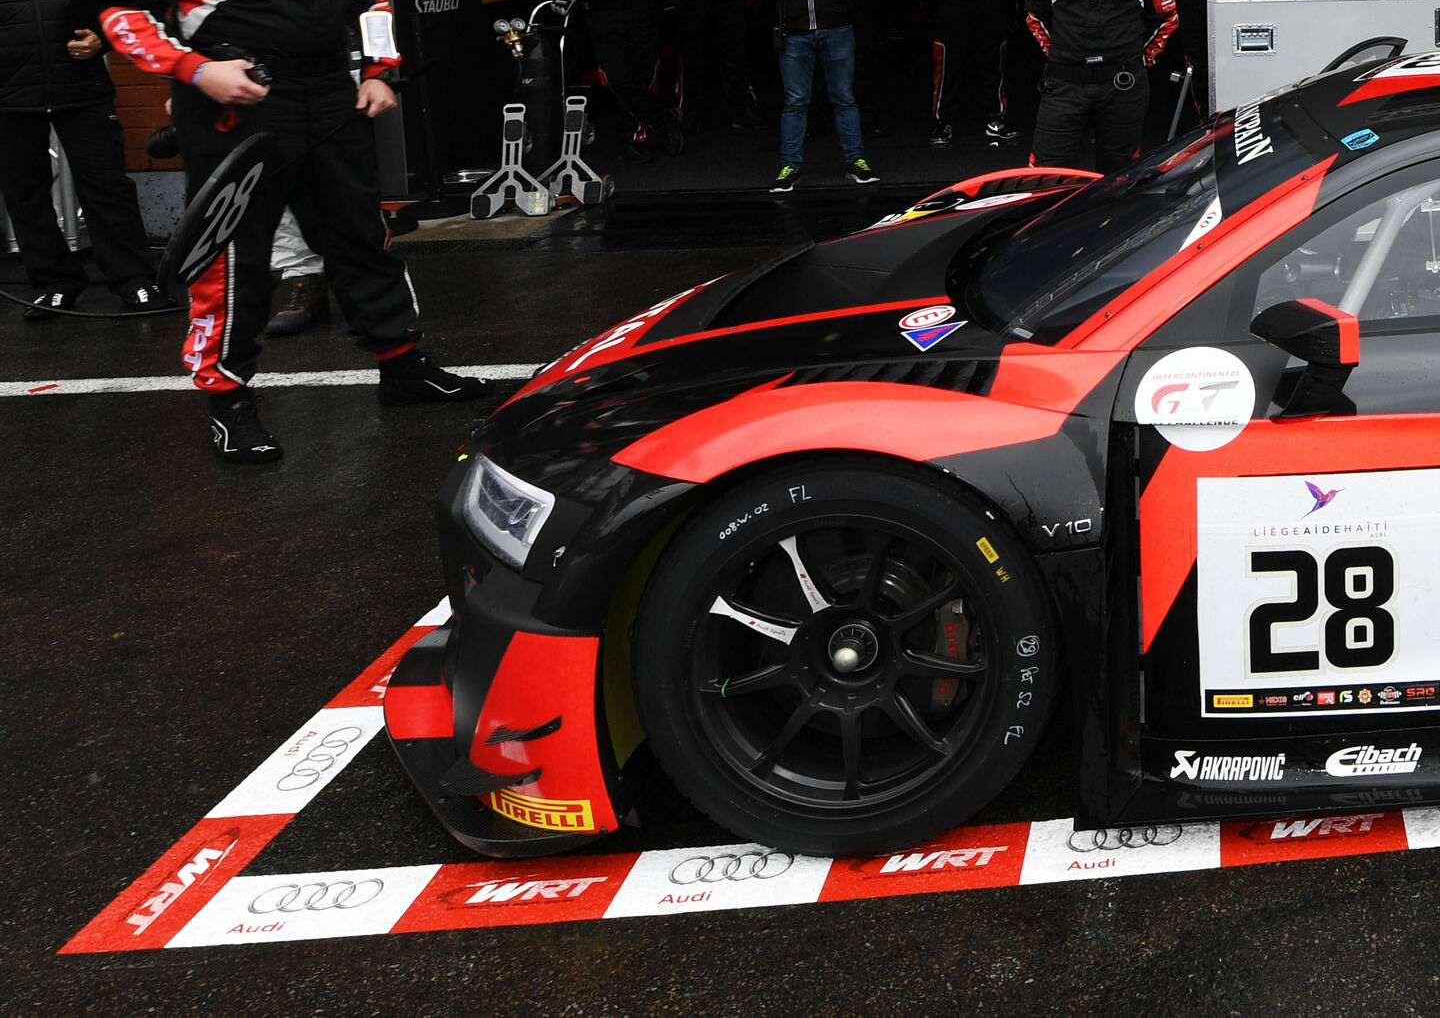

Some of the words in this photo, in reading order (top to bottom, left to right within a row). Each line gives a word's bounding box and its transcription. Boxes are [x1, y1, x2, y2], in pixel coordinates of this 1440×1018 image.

[179, 162, 264, 275] 28
[1152, 370, 1240, 381] INTERCONTINENTAL
[789, 485, 812, 504] FL
[1250, 546, 1394, 674] 28
[1018, 637, 1038, 655] 28
[1216, 696, 1250, 706] PIRELLI
[1406, 687, 1435, 697] SRO
[284, 731, 318, 757] Audi
[1326, 743, 1422, 776] Eibach
[496, 790, 585, 828] PIRELLI
[1270, 813, 1384, 840] WRT
[879, 846, 1009, 873] WRT
[1066, 858, 1116, 871] Audi
[126, 847, 223, 936] WRT
[465, 877, 609, 904] WRT
[657, 890, 715, 905] Audi
[226, 921, 287, 935] Audi
